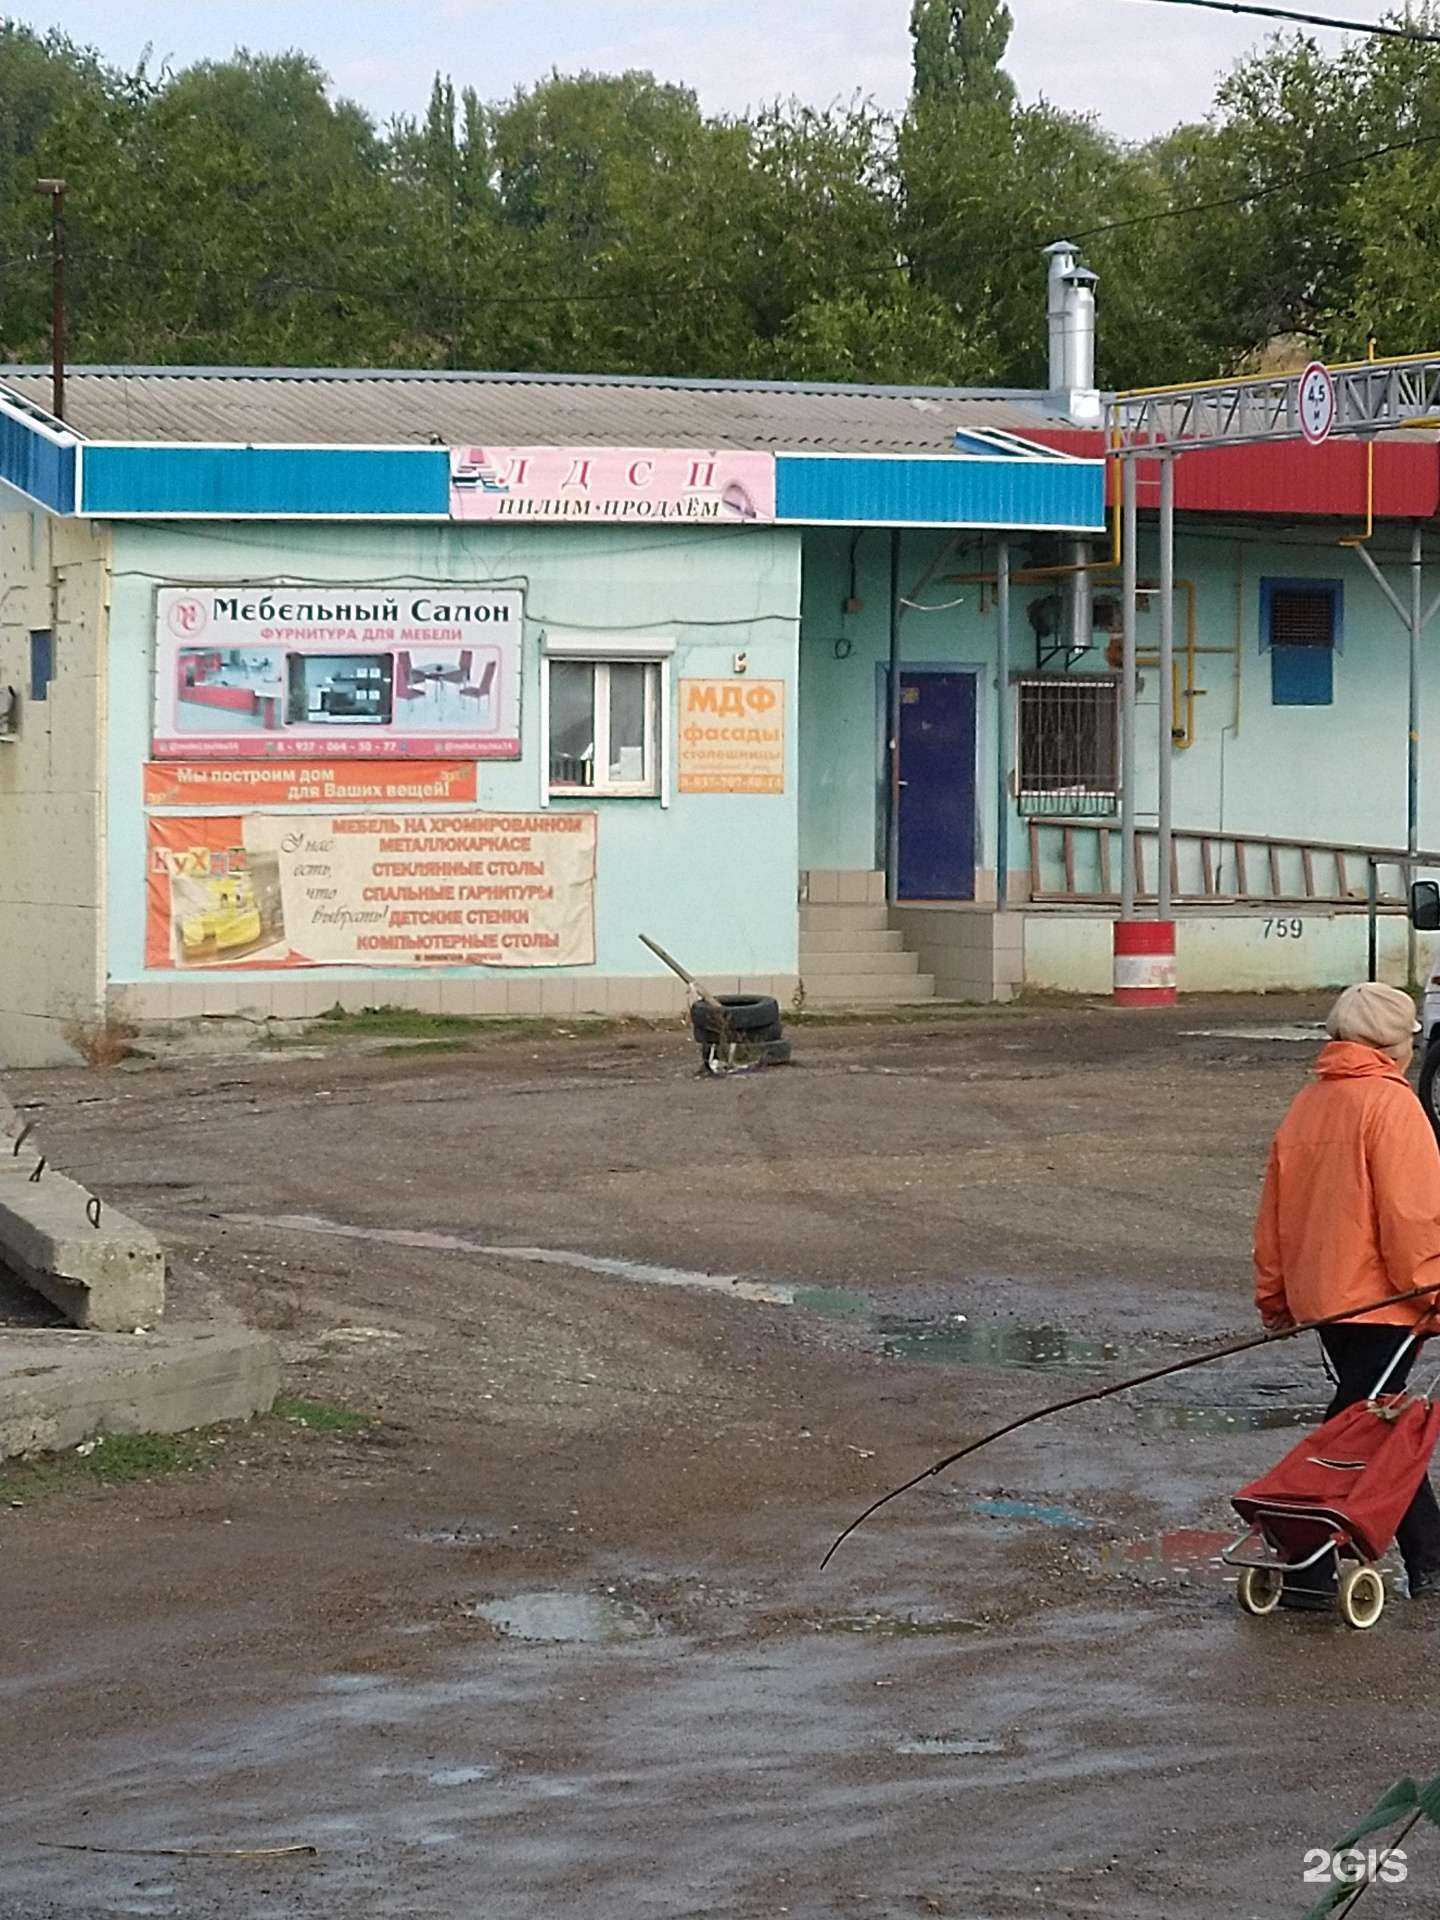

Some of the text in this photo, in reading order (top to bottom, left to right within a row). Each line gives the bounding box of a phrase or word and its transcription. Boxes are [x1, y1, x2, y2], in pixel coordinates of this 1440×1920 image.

[213, 596, 510, 622] Мебельный Салон
[260, 628, 463, 641] ФУРНИТУРА ДЛЯ МЕБЕЛИ
[687, 687, 776, 717] МДФ
[683, 722, 780, 746] фасады
[176, 768, 335, 784] Мы построим дом
[288, 781, 449, 799] для Ваших вещей!
[332, 818, 582, 834] МЕБЕЛЬ НА ХРОМИРОВАННОМ
[379, 837, 531, 852] МЕТАЛЛОКАРКАСЕ
[372, 860, 545, 877] СТЕКЛЯННЫЕ СТОЛЫ
[306, 887, 337, 900] что
[362, 885, 554, 901] СПАЛЬНЫЕ ГАРНИТУРЫ
[389, 909, 529, 927] ДЕТСКИЕ СТЕНКИ
[1262, 919, 1303, 939] 759
[357, 933, 559, 950] КОМПЬЮТЕРНЫЕ СТОЛЫ
